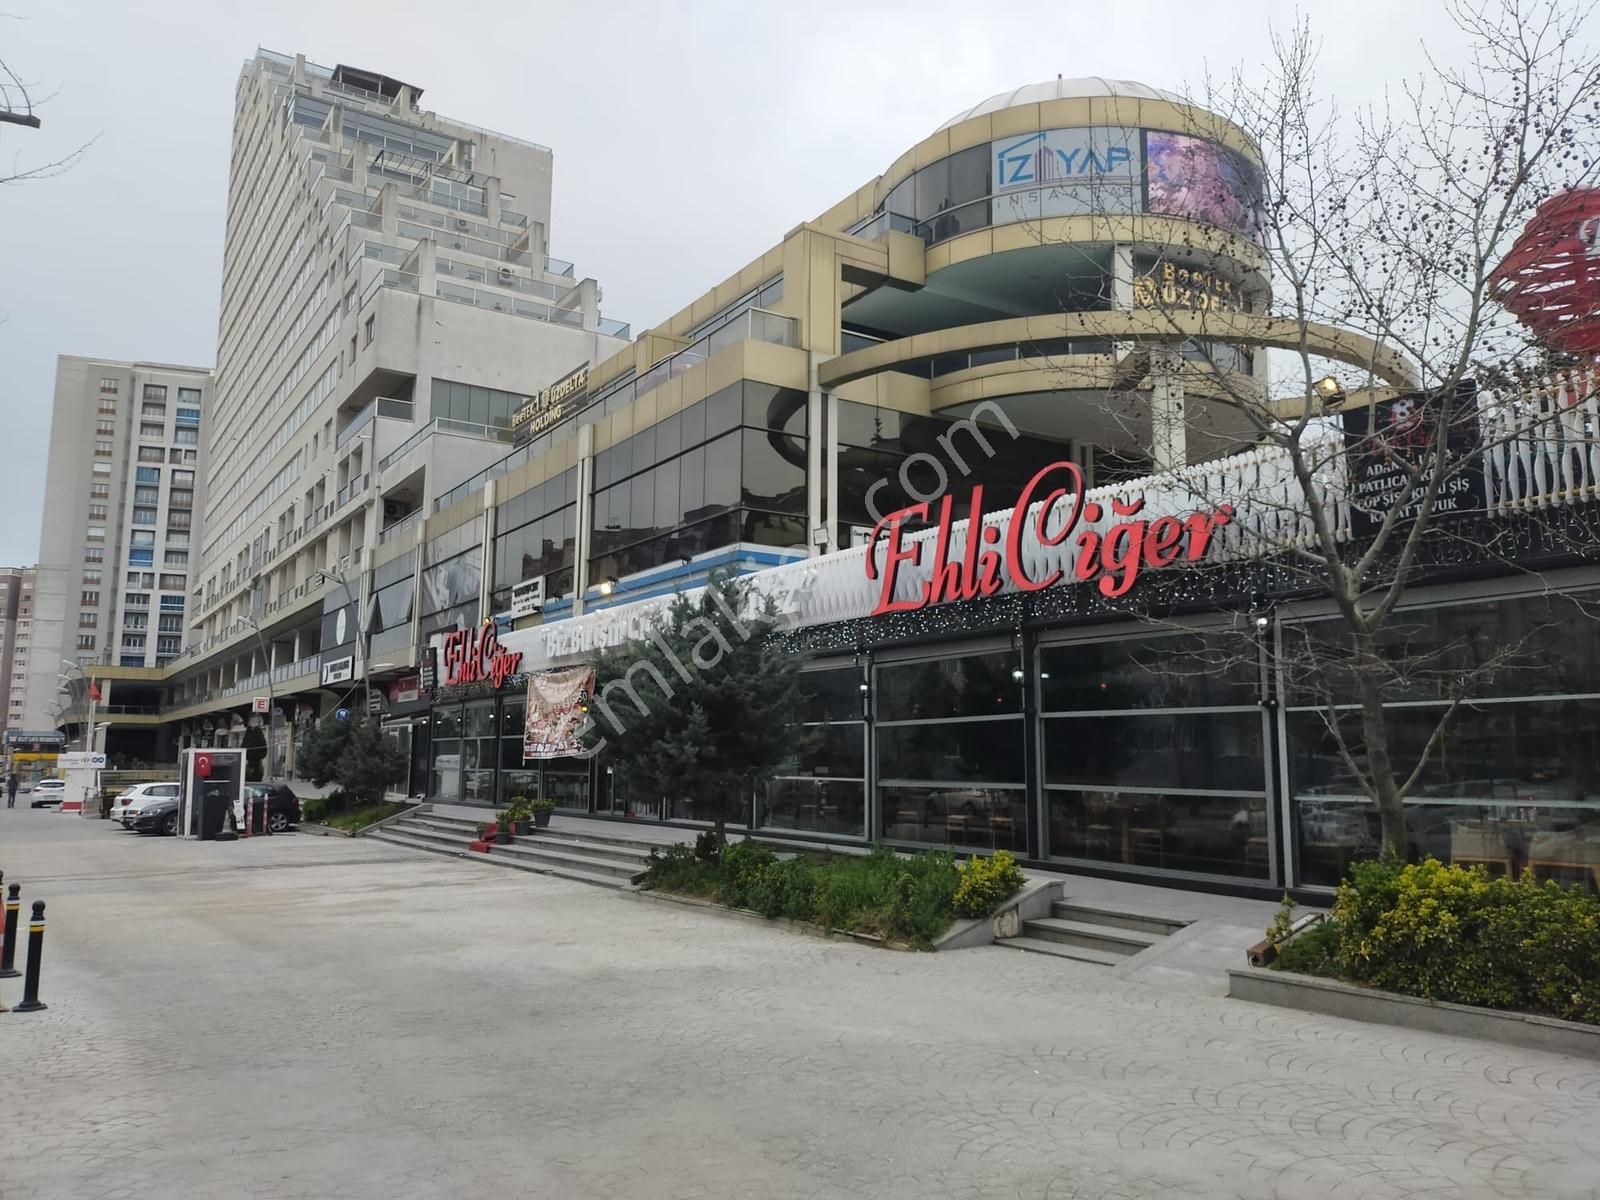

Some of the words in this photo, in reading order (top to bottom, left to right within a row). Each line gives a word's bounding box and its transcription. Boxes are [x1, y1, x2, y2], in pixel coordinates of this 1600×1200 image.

[1359, 474, 1411, 493] PATLICA
[1411, 485, 1446, 499] KUU
[1370, 506, 1411, 523] KAAT
[1414, 498, 1458, 515] TVUK
